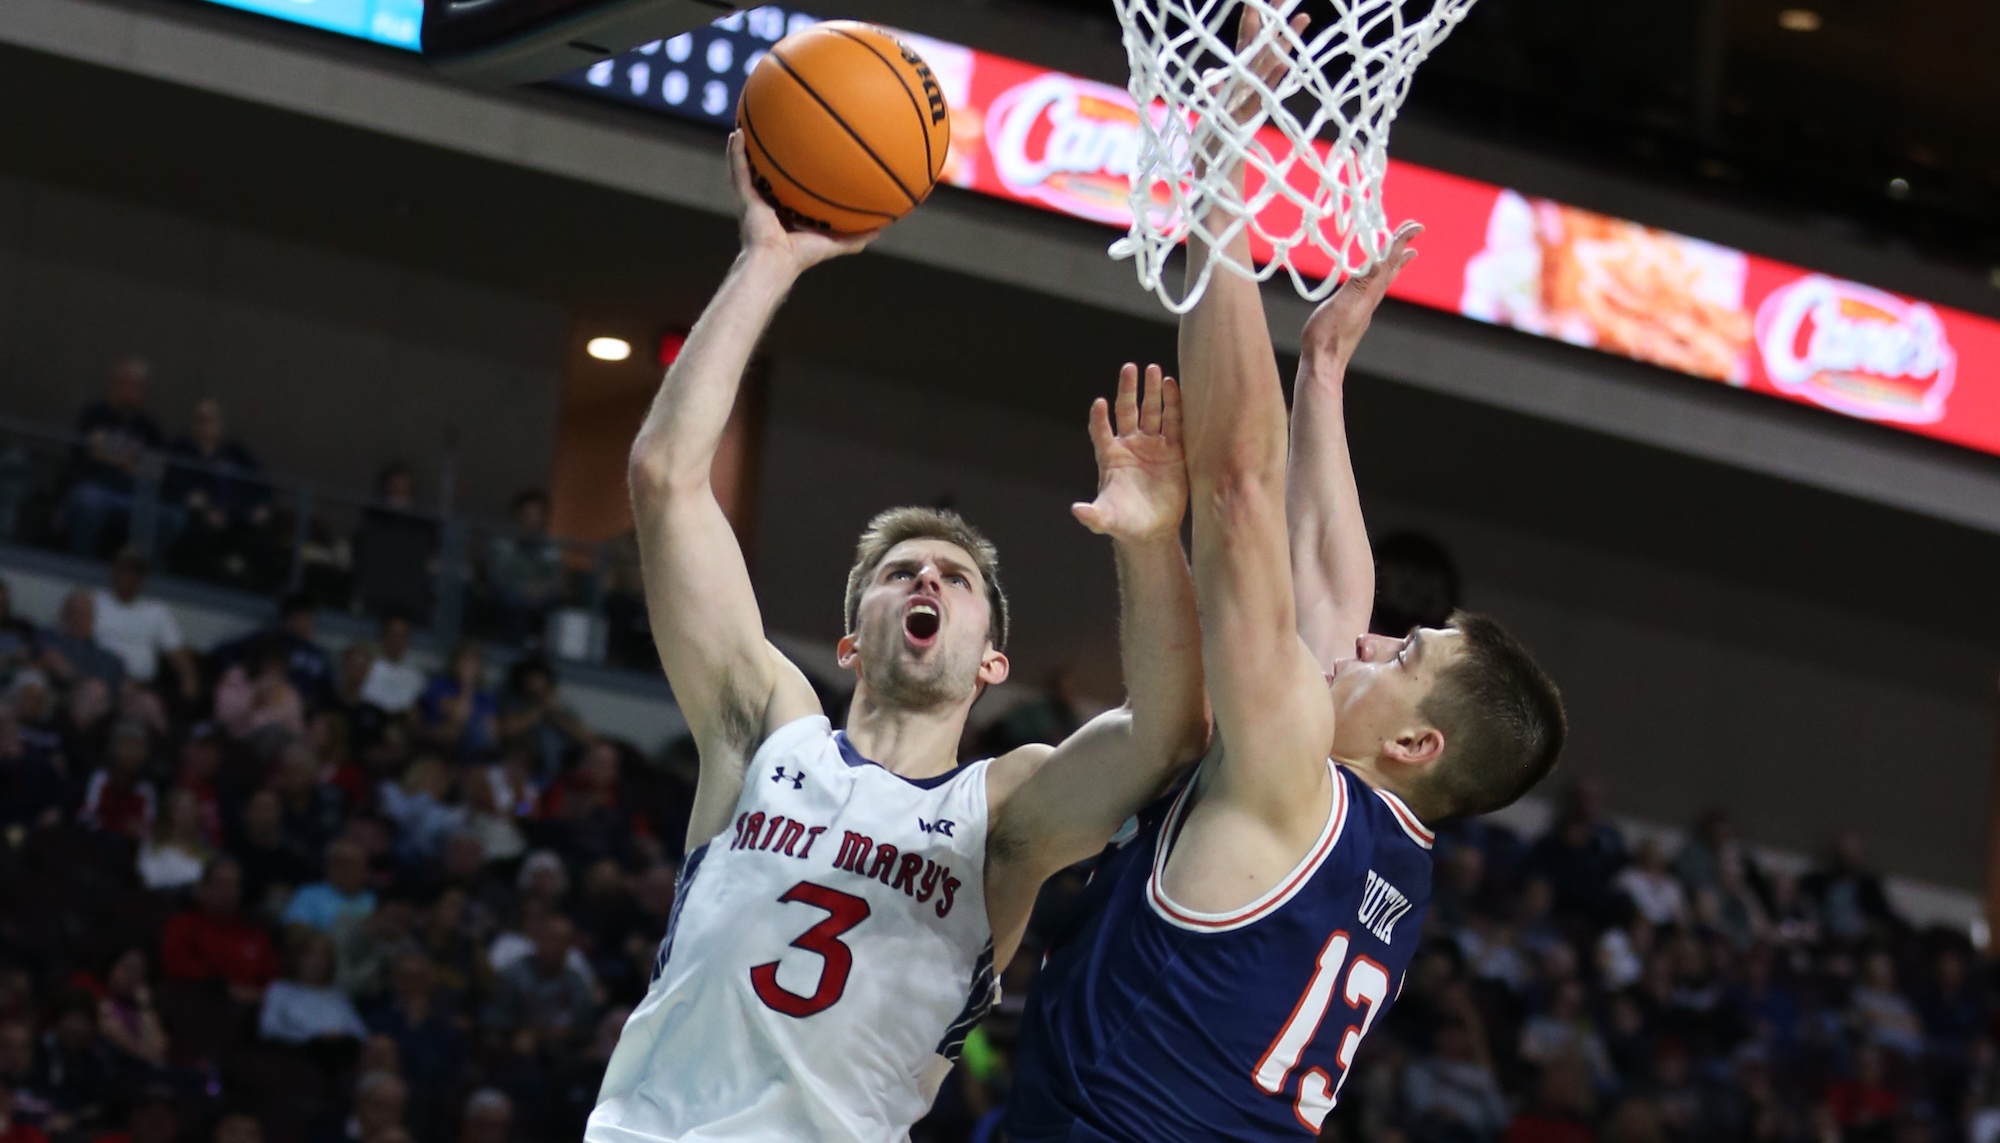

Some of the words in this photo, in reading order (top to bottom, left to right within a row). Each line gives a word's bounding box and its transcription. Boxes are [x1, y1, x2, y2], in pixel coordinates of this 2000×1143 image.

[730, 811, 827, 859] SAINT
[832, 830, 961, 918] MARY'S
[917, 816, 957, 839] WCC
[750, 880, 872, 1019] 3
[1251, 929, 1390, 1136] 13
